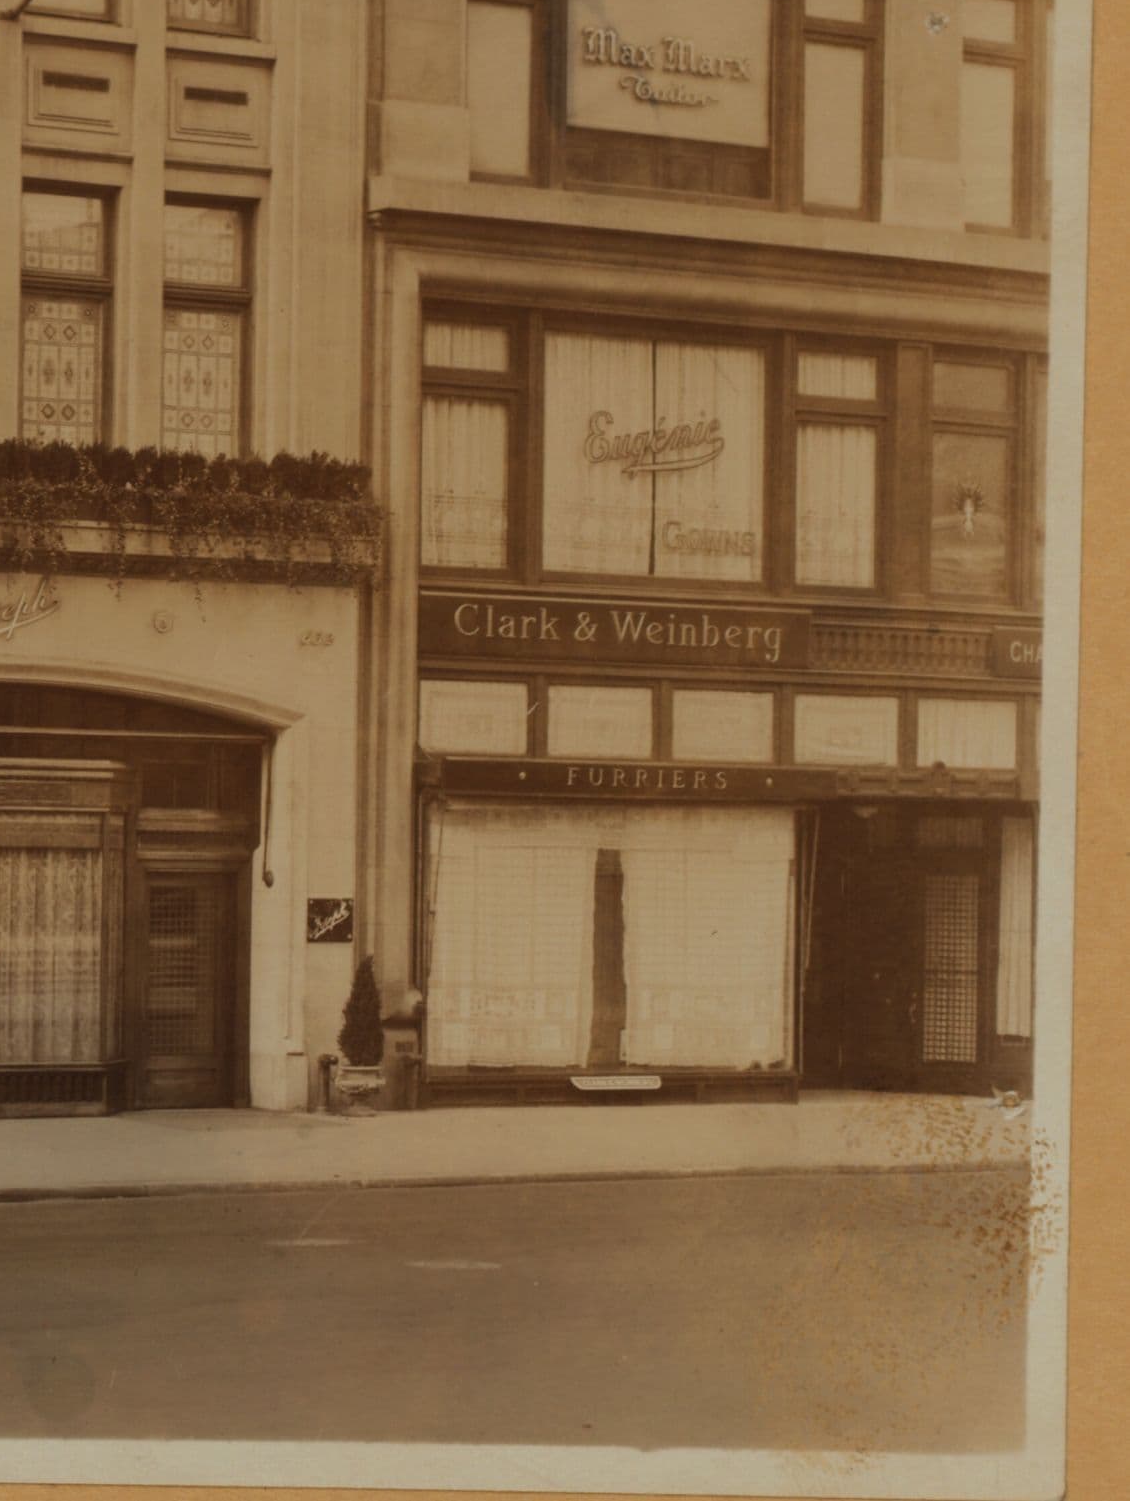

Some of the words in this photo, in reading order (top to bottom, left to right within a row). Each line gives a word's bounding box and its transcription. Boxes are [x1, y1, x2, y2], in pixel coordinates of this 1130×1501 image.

[581, 26, 654, 71] Max
[659, 37, 754, 82] Marx
[453, 602, 561, 641] Clark
[573, 611, 599, 643] &
[609, 609, 786, 663] Weinberg
[566, 764, 730, 792] FURRIERS
